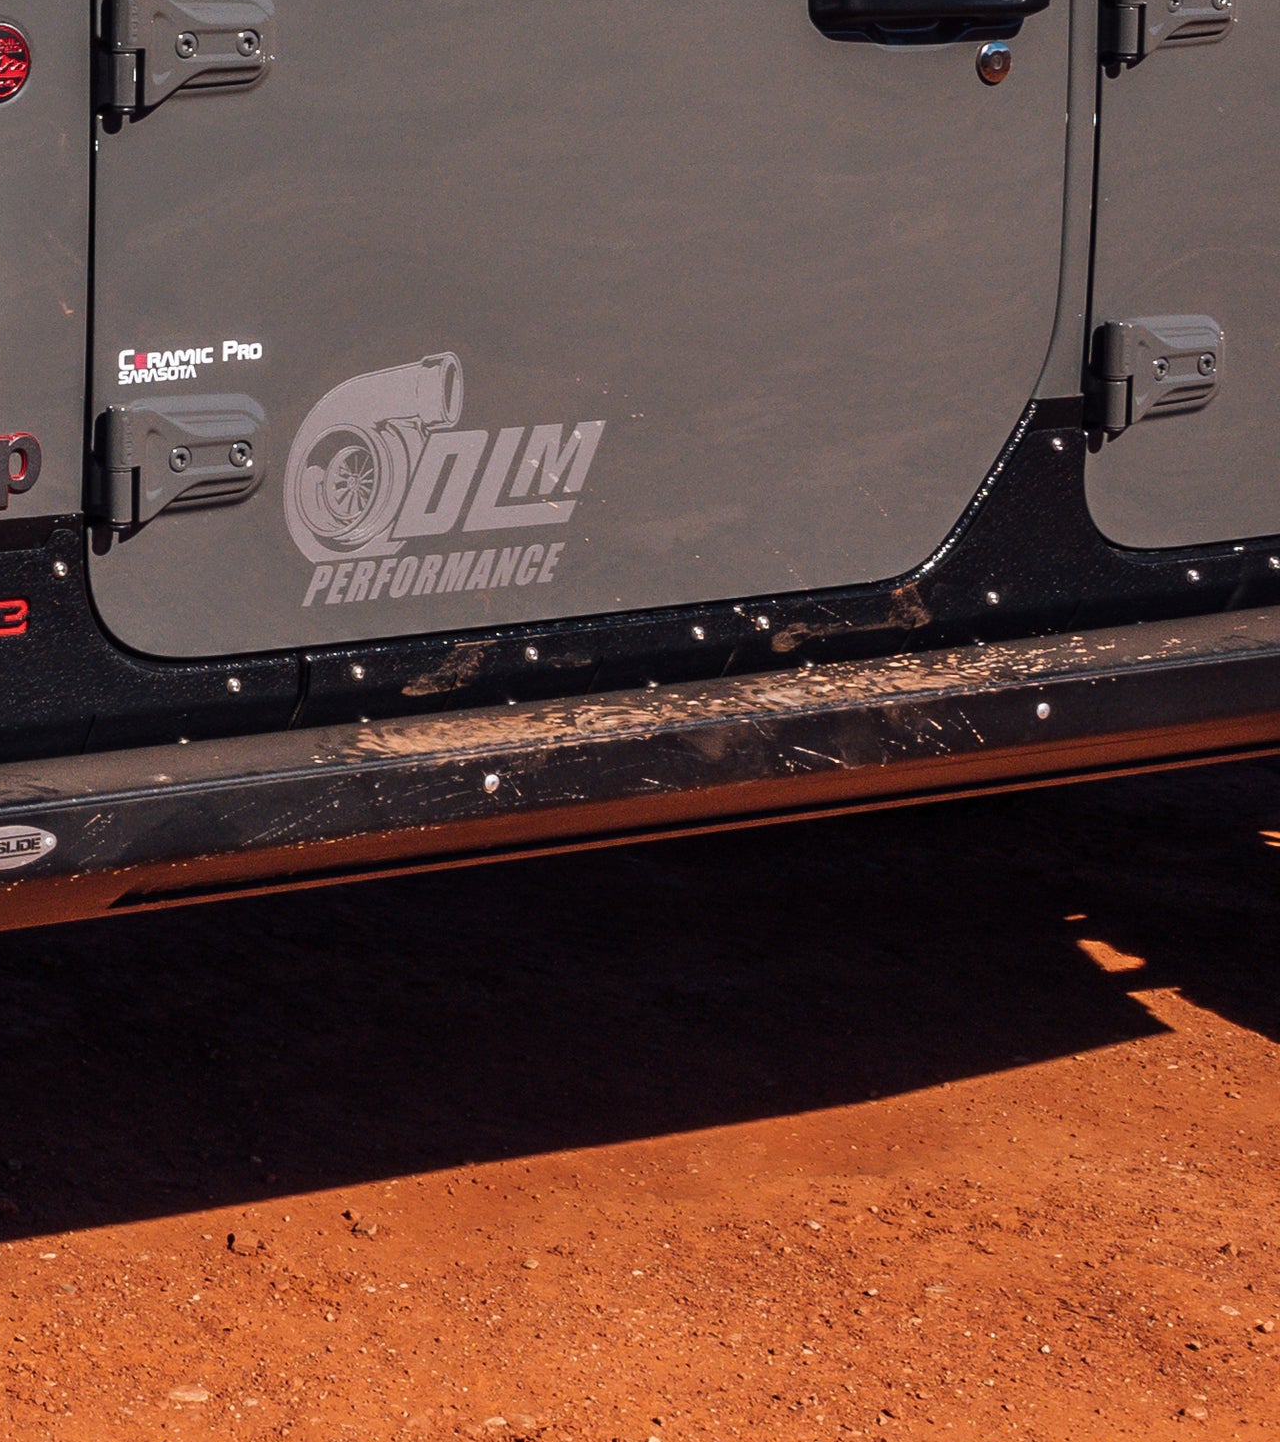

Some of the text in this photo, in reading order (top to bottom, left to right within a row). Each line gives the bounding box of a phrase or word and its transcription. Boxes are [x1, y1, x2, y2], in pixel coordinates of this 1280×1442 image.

[118, 365, 197, 385] SARASOTA
[390, 419, 607, 539] DLM
[301, 541, 566, 608] PERFORMANCE
